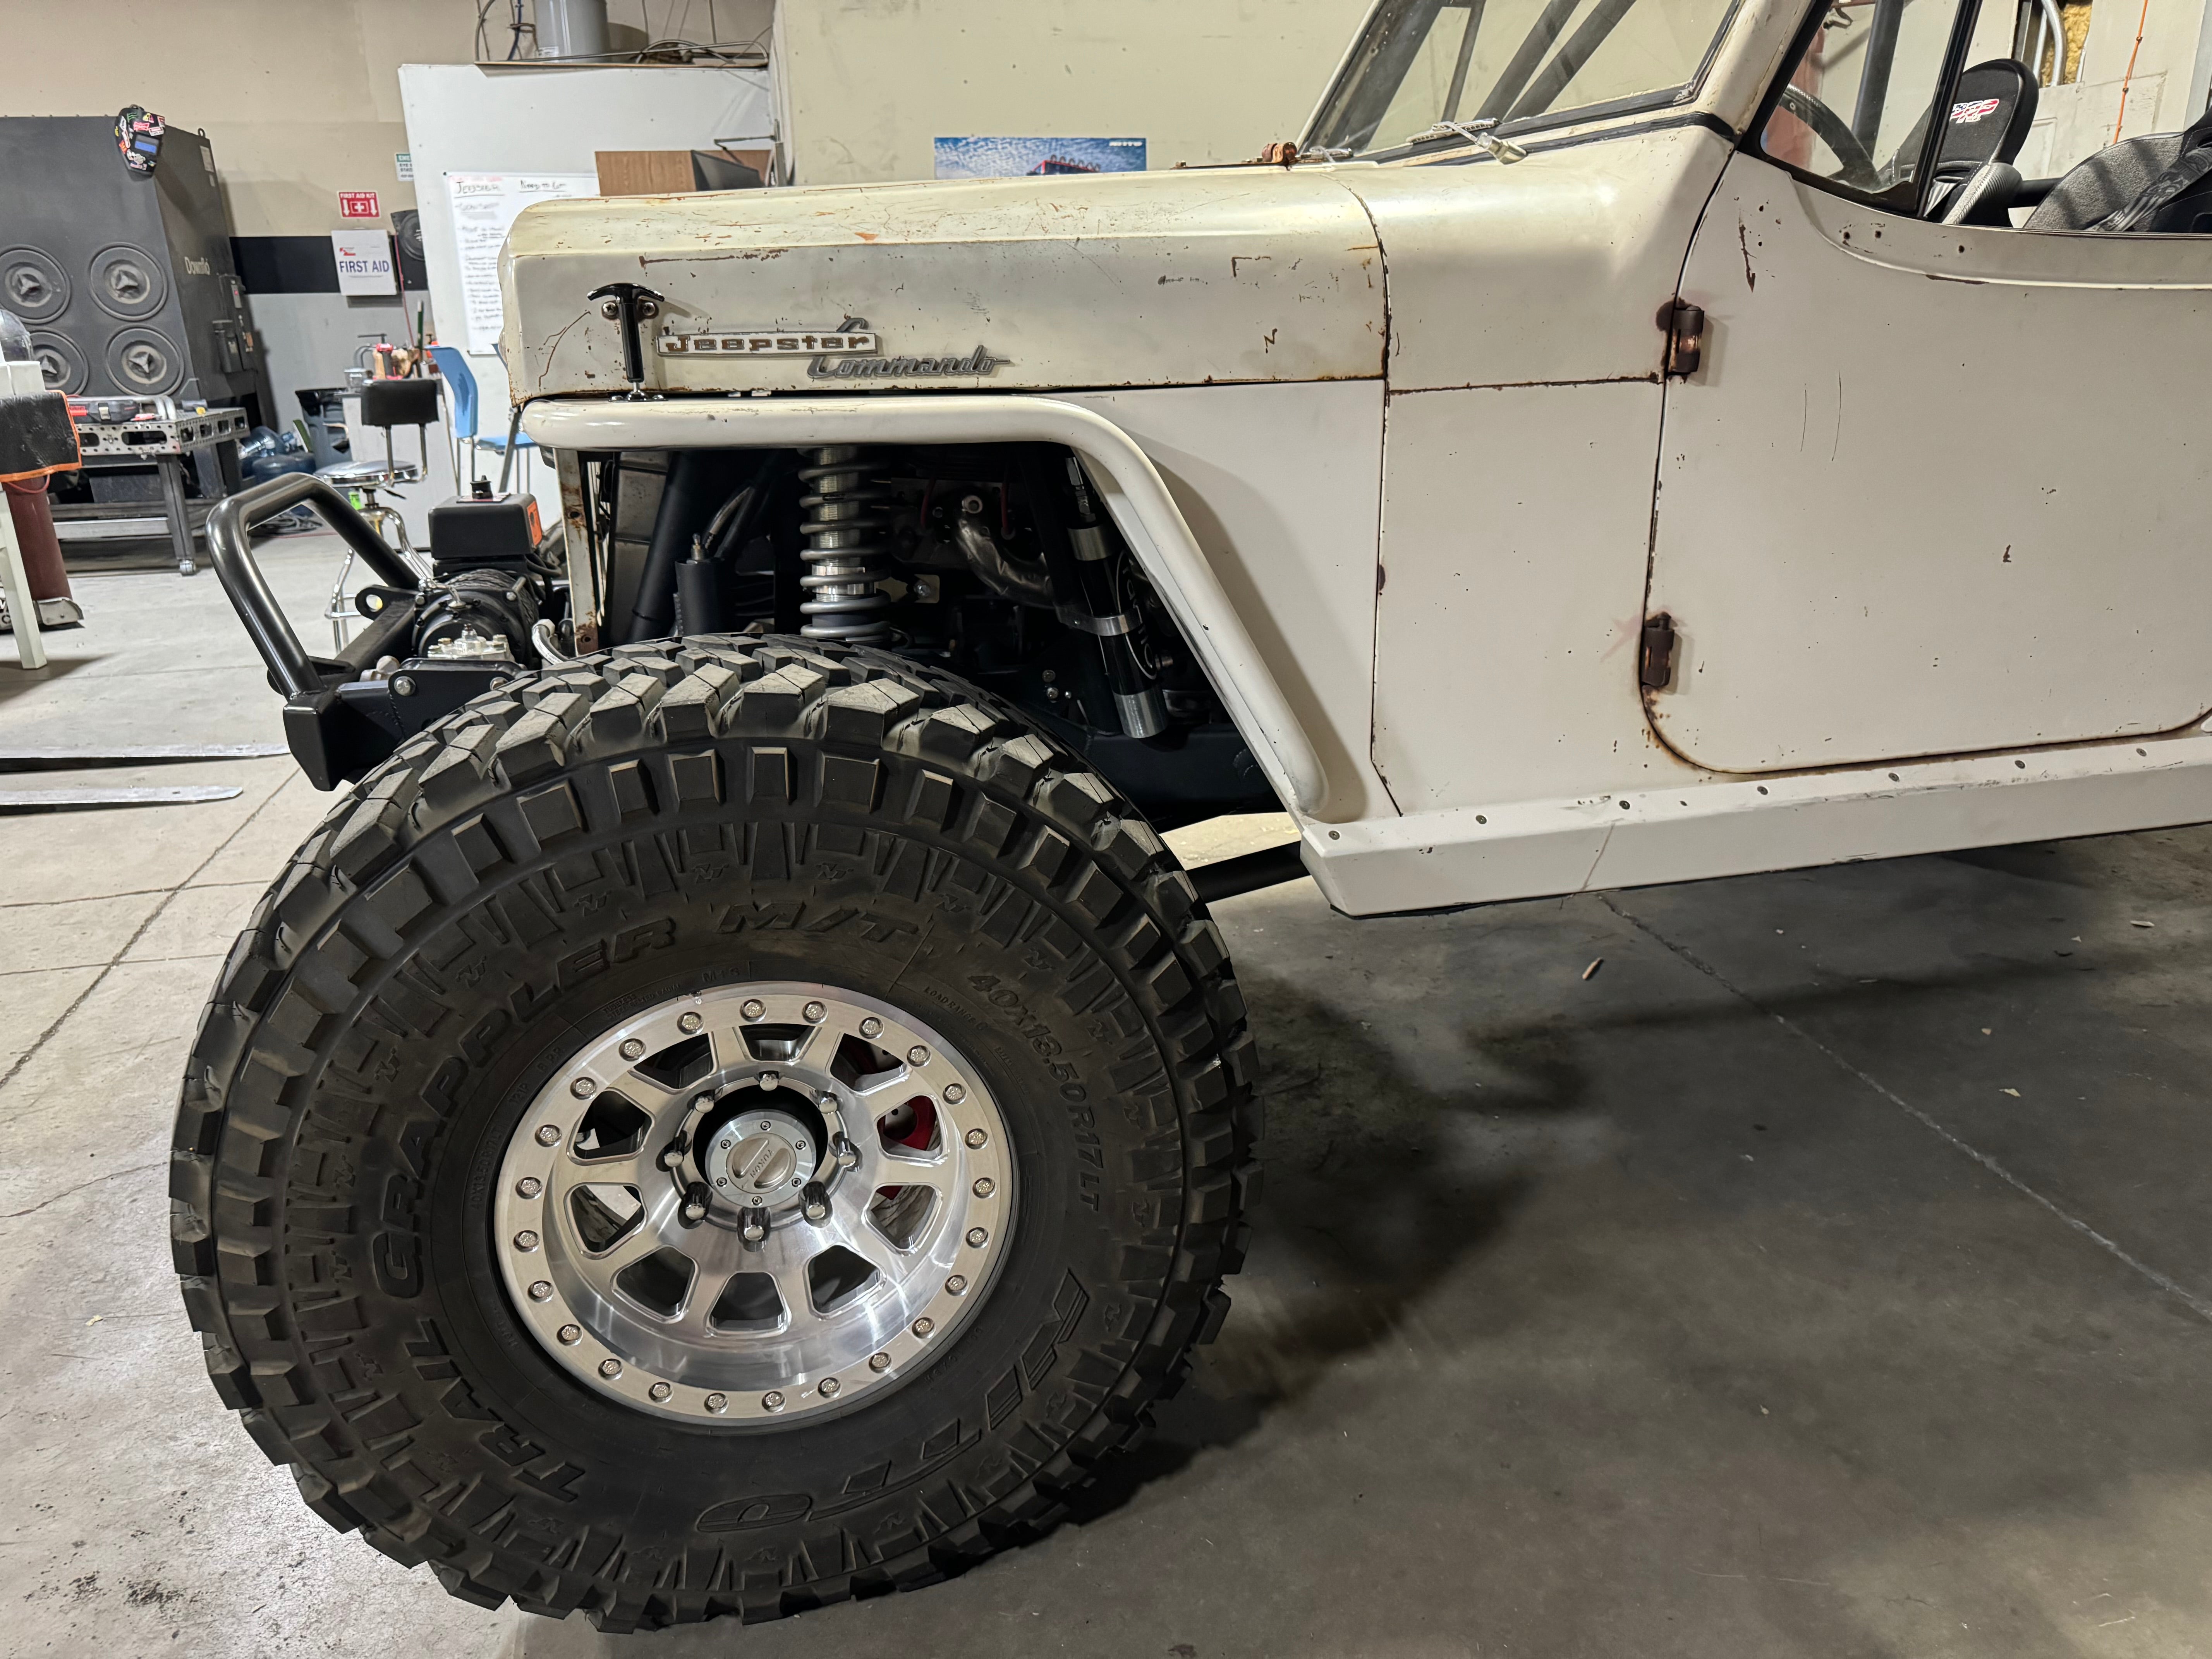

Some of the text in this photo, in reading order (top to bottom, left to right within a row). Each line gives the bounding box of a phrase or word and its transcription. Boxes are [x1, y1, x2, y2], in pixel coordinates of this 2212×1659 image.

[339, 260, 390, 273] FIRST AID
[666, 335, 870, 352] Jeepster
[924, 986, 949, 1003] LOAD
[948, 1001, 976, 1024] RANGE
[373, 900, 920, 1298] GRAPPLER M/T
[750, 1149, 775, 1179] YUKON
[405, 1318, 586, 1502] TRAIL
[696, 1268, 1090, 1533] NITTO
